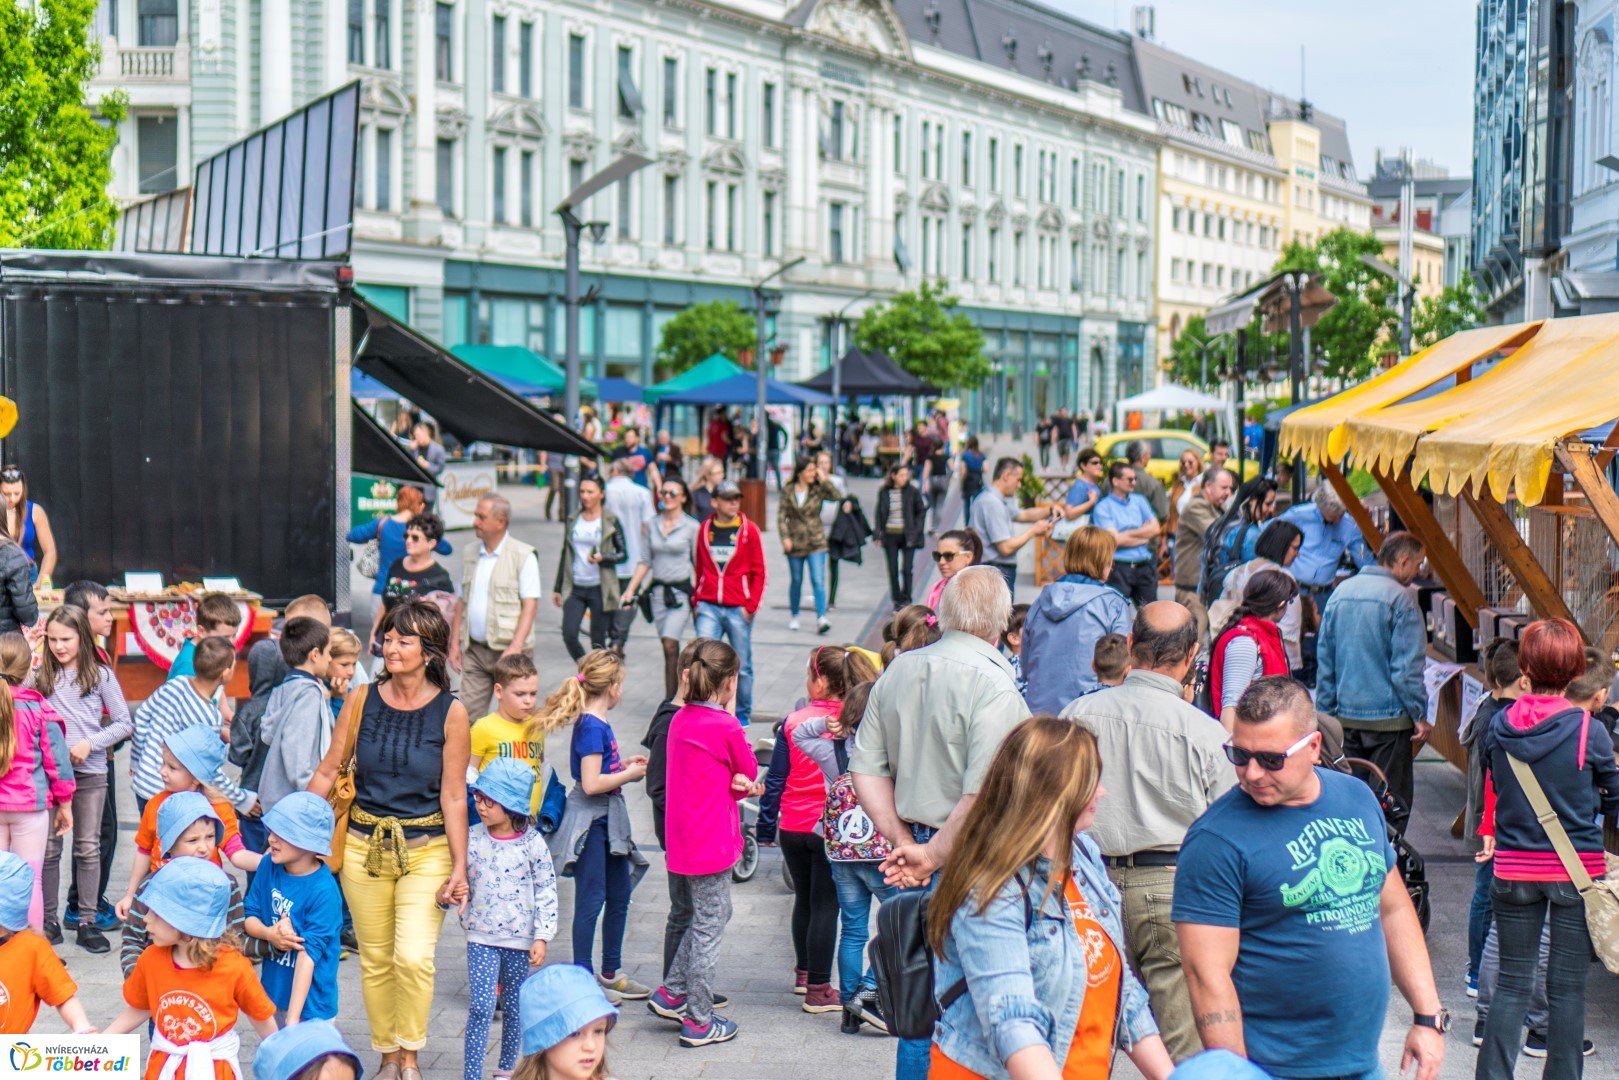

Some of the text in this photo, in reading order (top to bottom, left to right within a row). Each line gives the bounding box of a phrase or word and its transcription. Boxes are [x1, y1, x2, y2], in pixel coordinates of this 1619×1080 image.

[498, 741, 541, 759] DINOS
[1286, 817, 1373, 868] REFINERY
[159, 995, 213, 1024] ÖNGYSZEM
